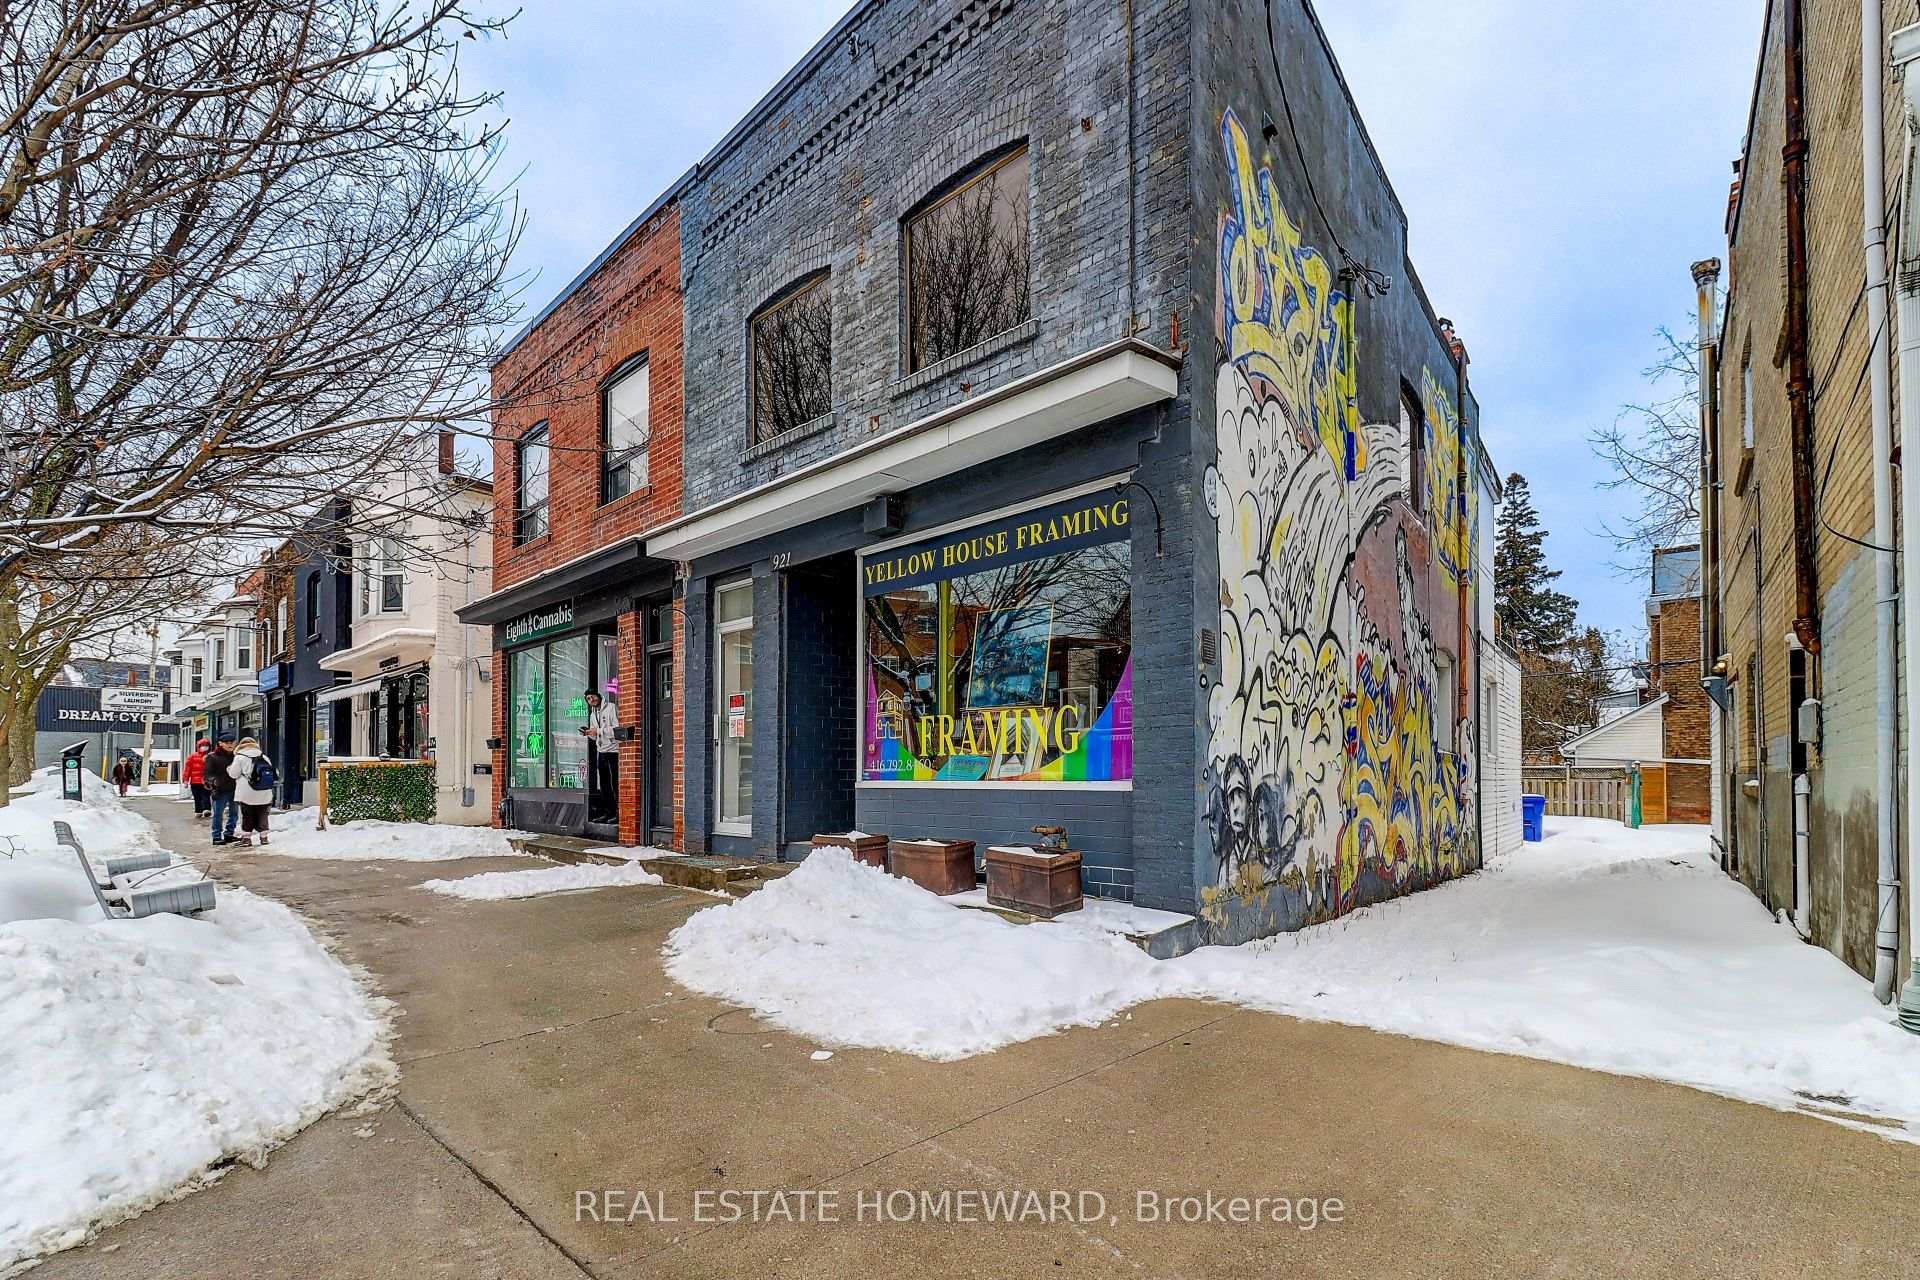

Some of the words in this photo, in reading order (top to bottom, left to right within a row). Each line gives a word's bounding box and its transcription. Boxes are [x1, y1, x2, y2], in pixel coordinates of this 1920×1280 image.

[773, 551, 791, 570] 921
[865, 549, 937, 585] YELLOW
[942, 531, 1009, 568] HOUSE
[1015, 499, 1129, 550] FRAMING
[506, 621, 529, 642] Eighth
[533, 604, 573, 631] Cannabis
[119, 691, 159, 699] SILVERBIRCH
[919, 704, 1081, 757] FRAMING
